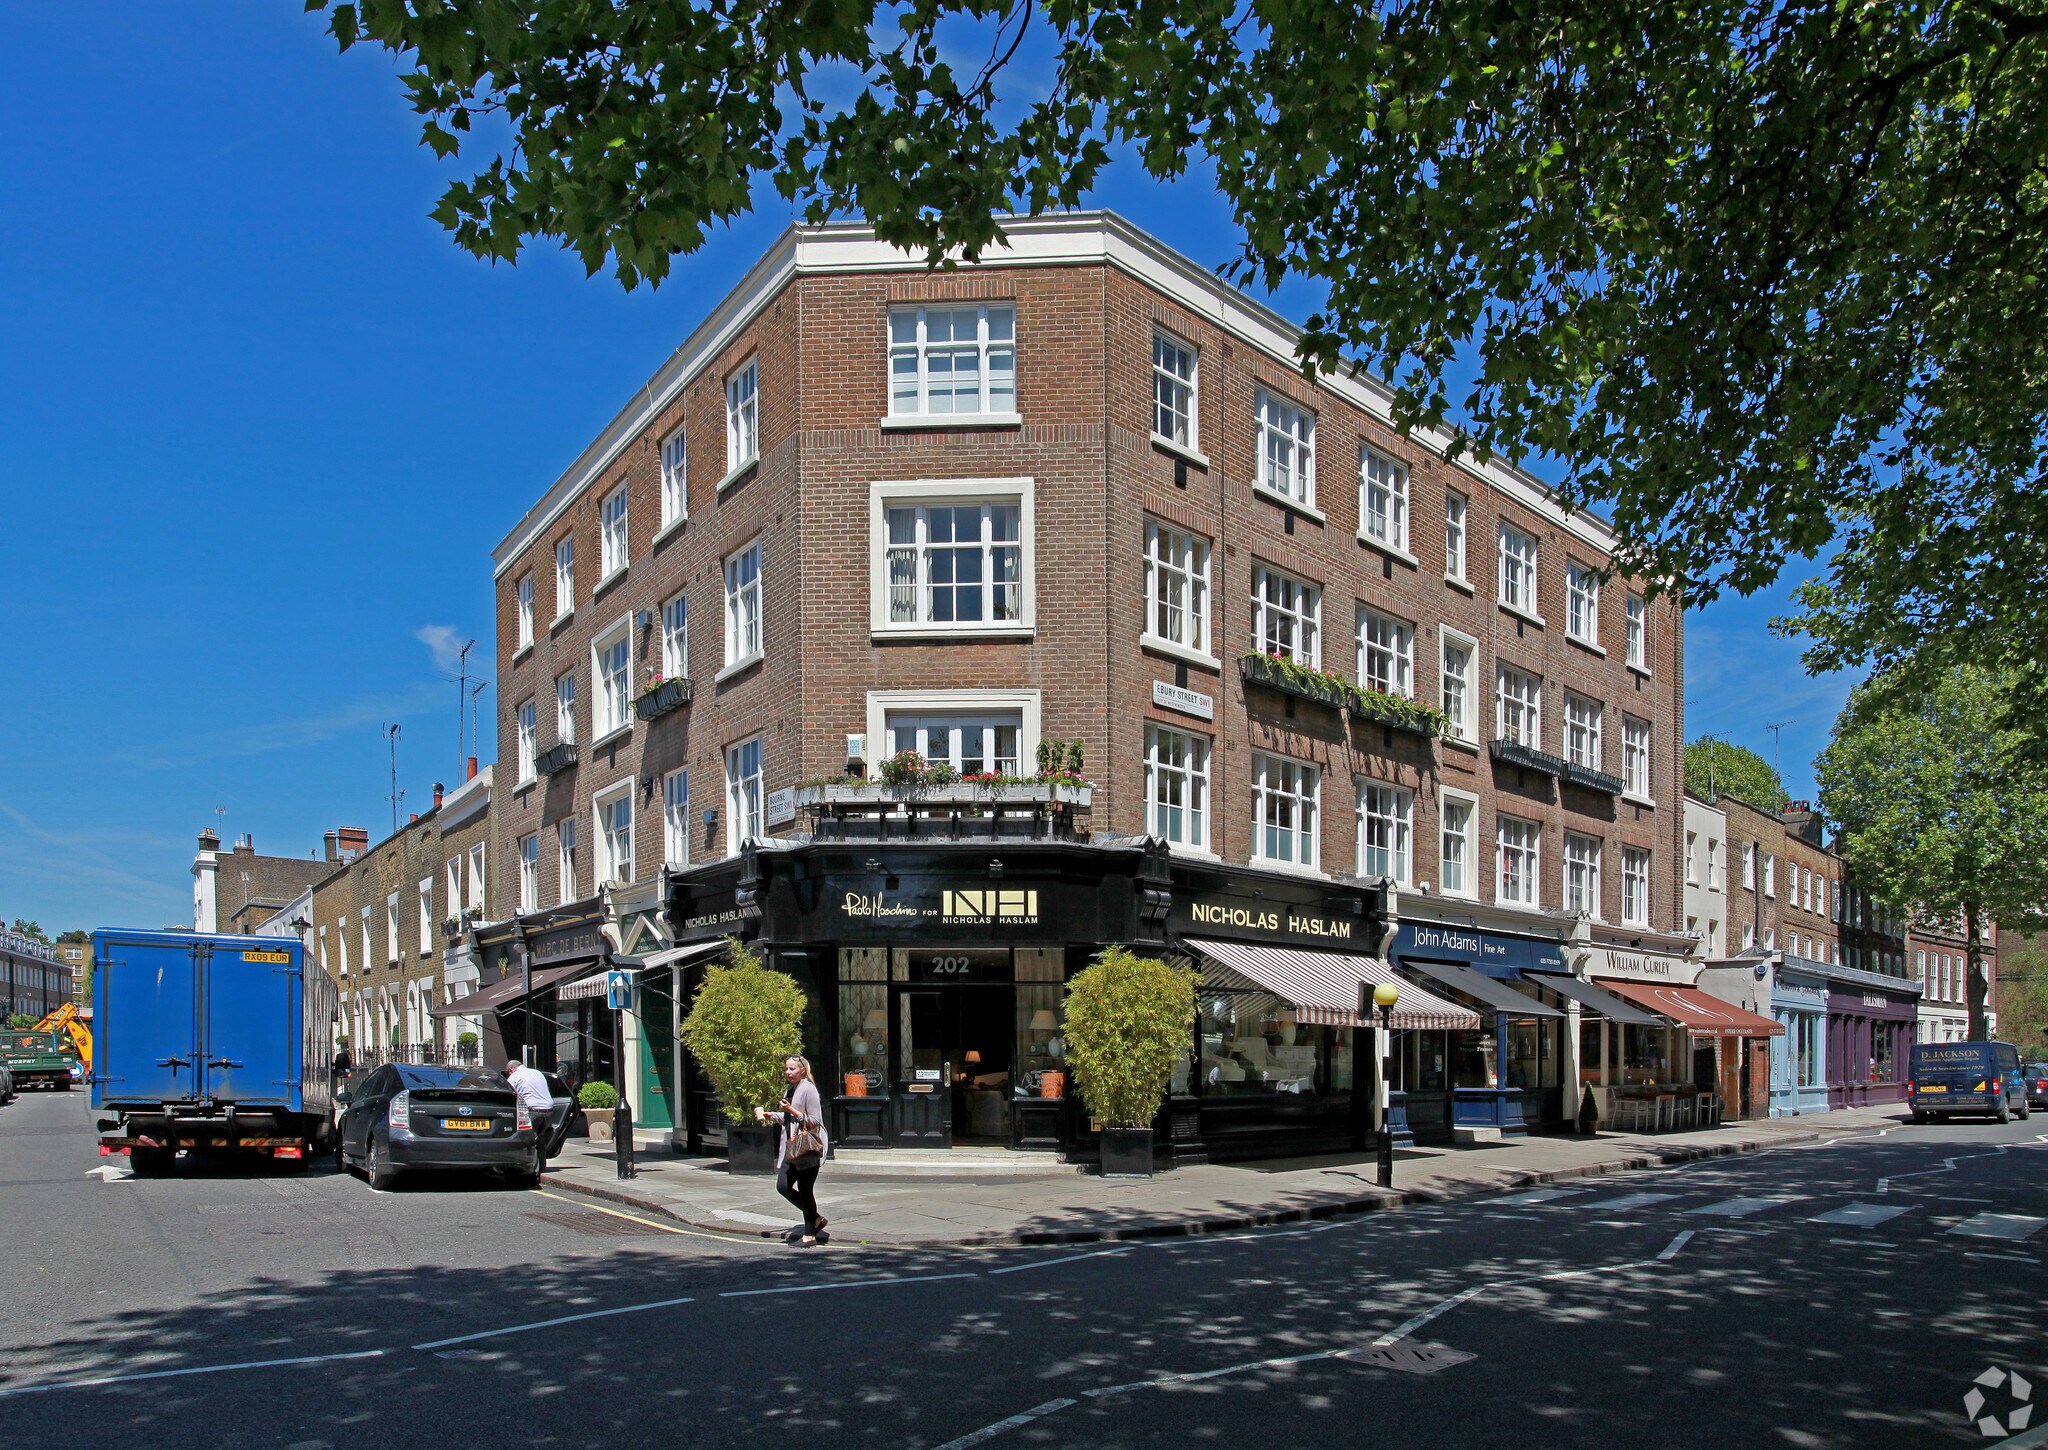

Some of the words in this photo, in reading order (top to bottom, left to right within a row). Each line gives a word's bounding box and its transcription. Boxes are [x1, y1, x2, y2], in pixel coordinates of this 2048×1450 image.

[1157, 684, 1176, 698] EBURY
[1177, 690, 1198, 704] STREET
[1200, 697, 1210, 708] SW1
[770, 802, 783, 815] STREET
[841, 892, 870, 917] Paolo
[686, 914, 717, 928] NICHOLAS
[1192, 903, 1278, 930] NICHOLAS
[1288, 916, 1350, 938] HASLAM
[1414, 926, 1439, 947] John
[1441, 930, 1477, 951] Adams
[536, 941, 556, 958] MARC
[560, 939, 569, 952] DE
[1484, 944, 1495, 954] Fine
[1497, 945, 1505, 954] Art
[245, 953, 268, 961] RX09
[932, 957, 970, 973] 202
[1607, 951, 1639, 972] WILLIAM
[1644, 956, 1670, 975] CURLEY
[1863, 992, 1887, 1008] TALISMAN
[1933, 1050, 1979, 1058] JACKSON
